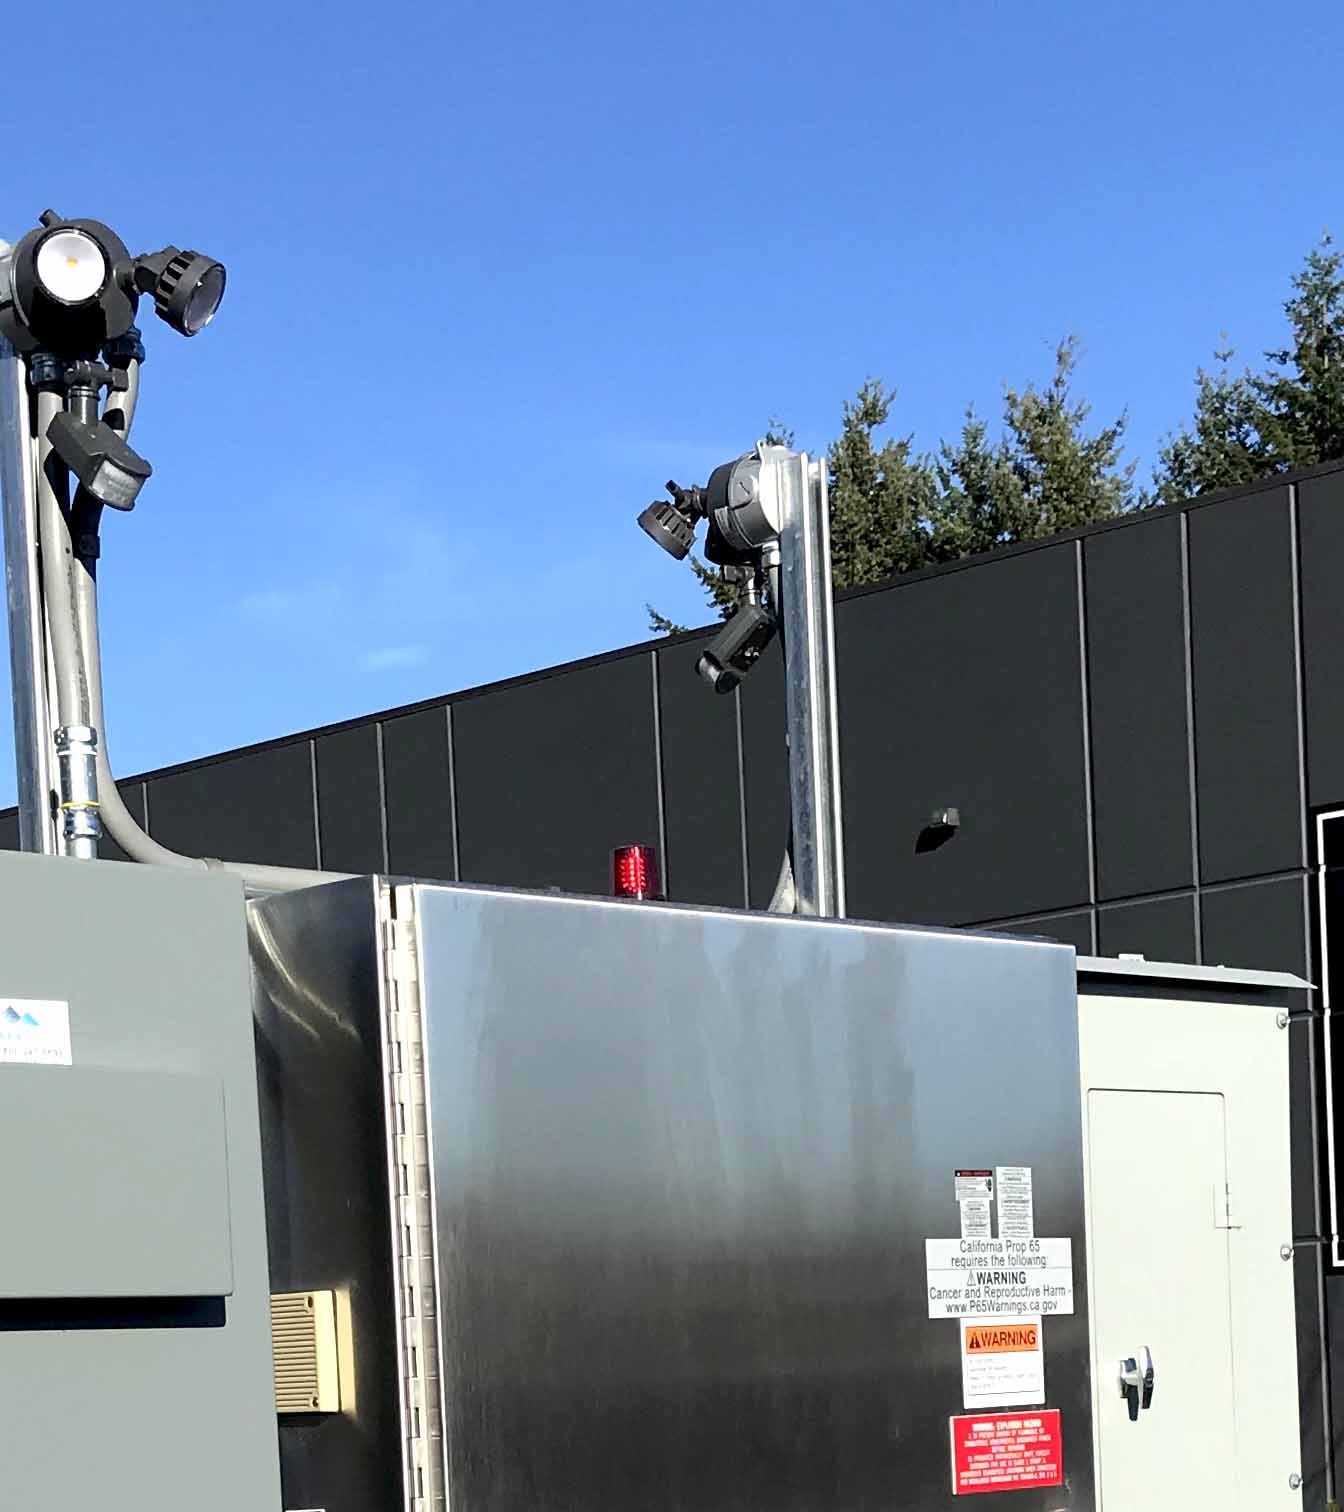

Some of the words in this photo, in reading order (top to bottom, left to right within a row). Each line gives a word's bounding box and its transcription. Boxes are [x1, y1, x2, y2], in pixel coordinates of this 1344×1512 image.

[960, 1239, 1003, 1253] California
[1006, 1239, 1027, 1254] Prop
[1029, 1239, 1041, 1252] 65
[951, 1255, 988, 1267] requires
[991, 1254, 1005, 1266] the
[976, 1271, 1027, 1285] WARNING
[929, 1286, 962, 1300] Cancer
[964, 1286, 981, 1299] and
[984, 1285, 1041, 1299] Reproductive
[1043, 1284, 1066, 1297] Harm
[980, 1330, 1036, 1347] WARNING
